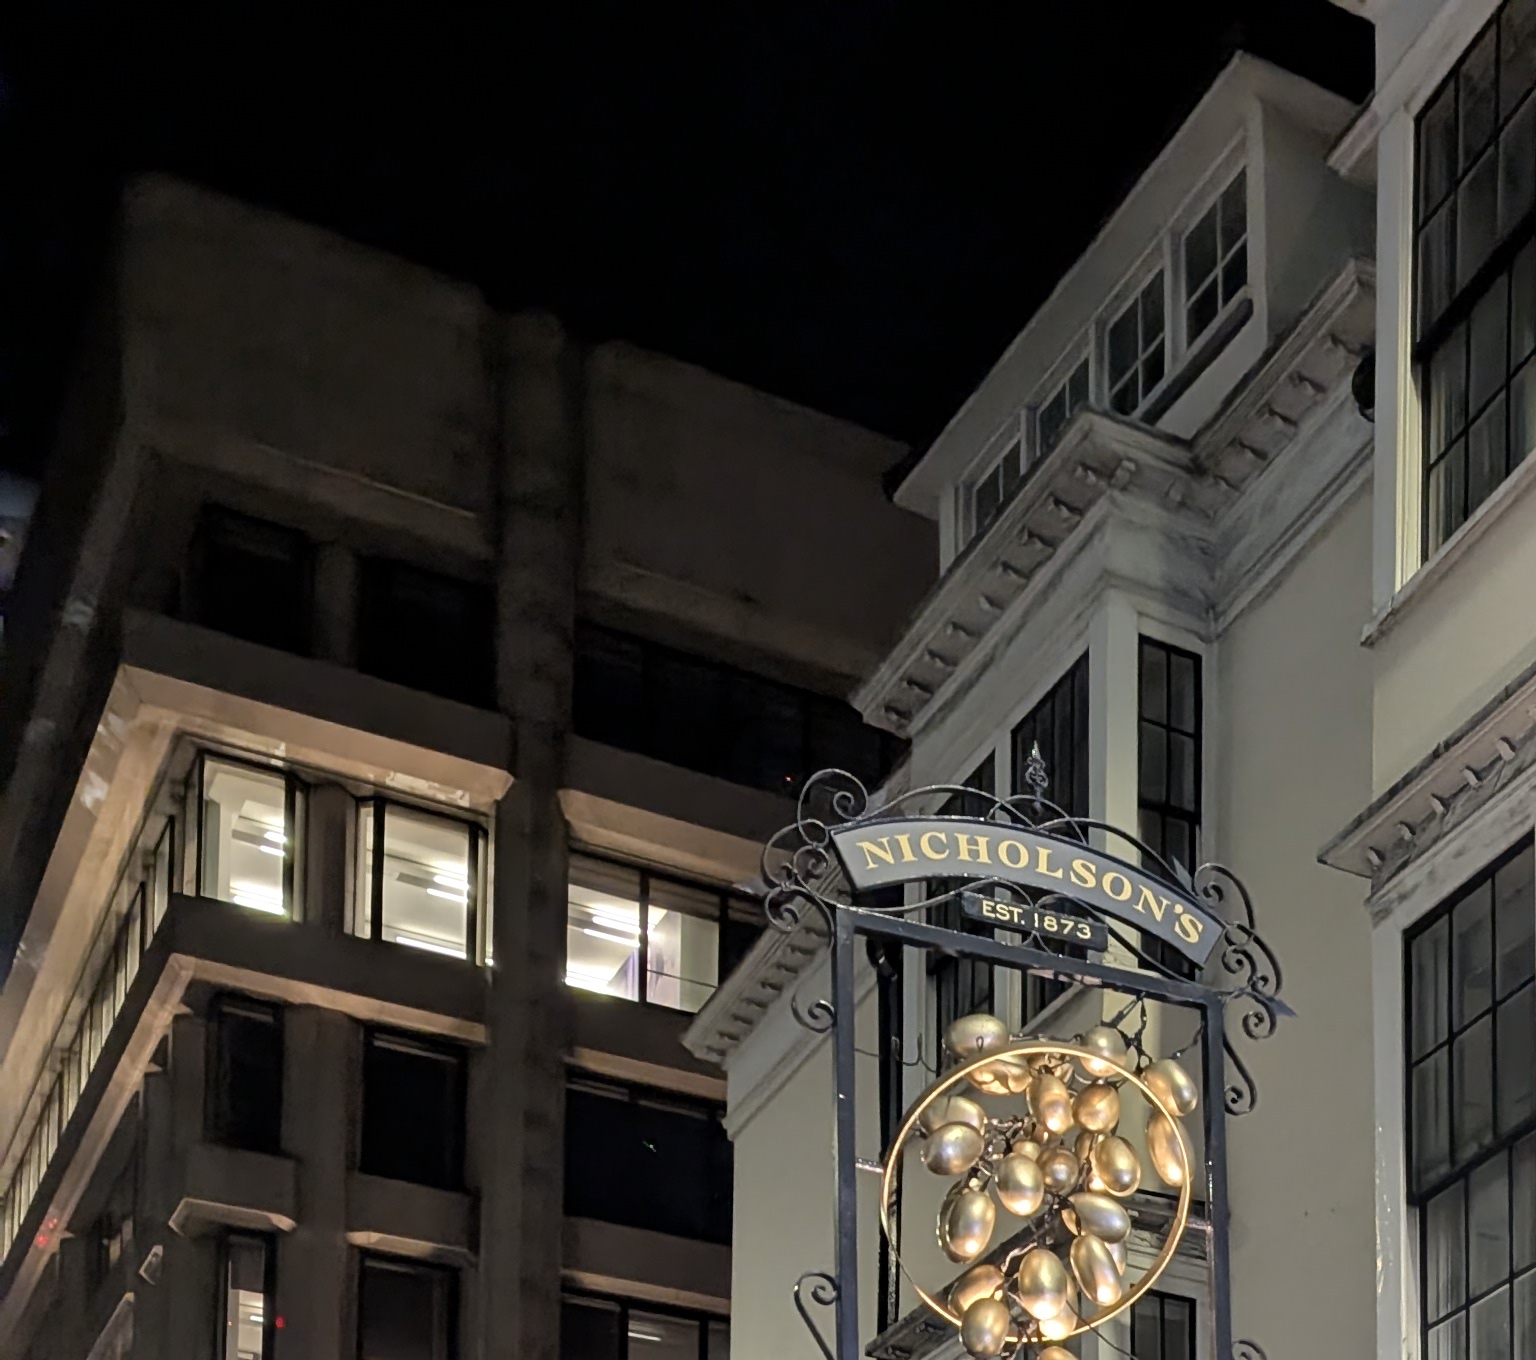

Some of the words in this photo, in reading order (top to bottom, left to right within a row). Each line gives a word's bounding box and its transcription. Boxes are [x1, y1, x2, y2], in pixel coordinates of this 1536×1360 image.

[855, 830, 1204, 945] NICHOLSON'S
[981, 900, 1026, 927] EST.
[1032, 912, 1093, 940] 1873
